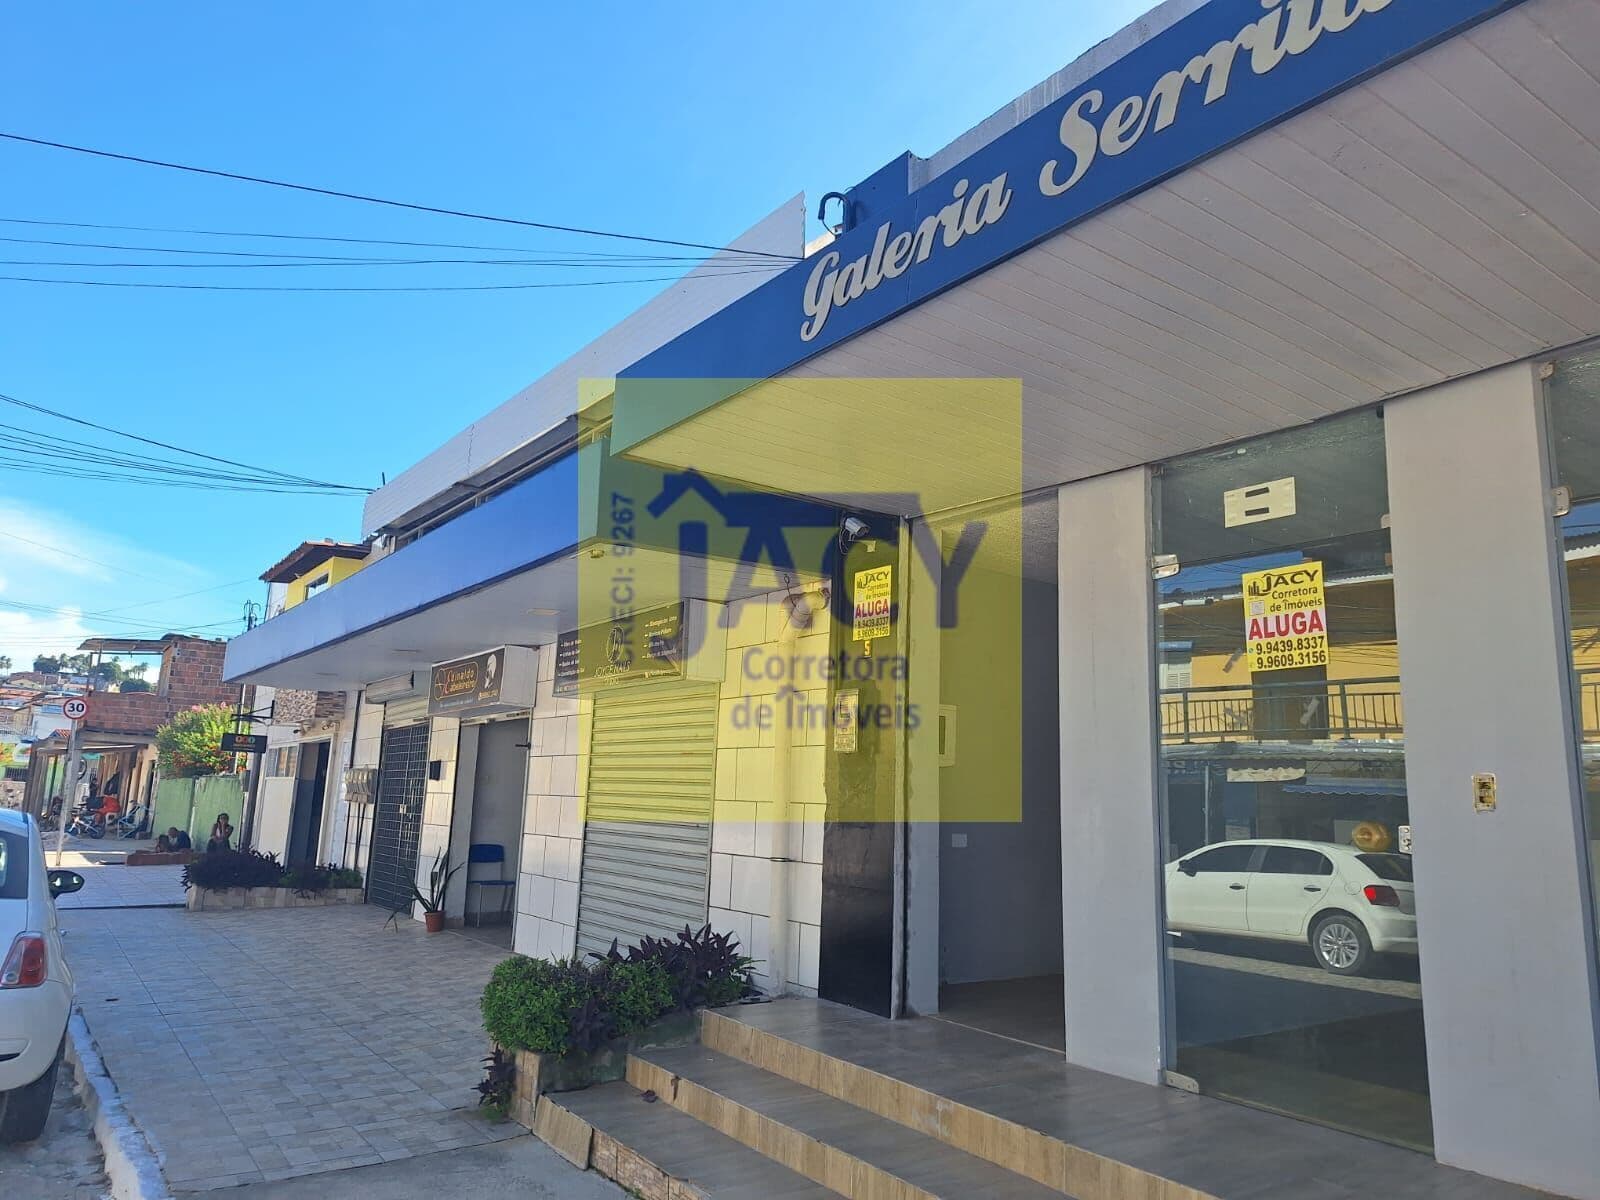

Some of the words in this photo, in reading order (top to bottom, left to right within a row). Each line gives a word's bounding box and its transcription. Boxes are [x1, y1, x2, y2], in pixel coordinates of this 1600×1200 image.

[799, 170, 1014, 342] Galeria
[1261, 569, 1319, 593] JACY
[1271, 586, 1318, 600] Corretora
[855, 598, 889, 619] ALUGA
[1269, 603, 1282, 612] de
[1248, 609, 1324, 641] ALUGA
[1255, 635, 1325, 656] 9.9439.8337
[1256, 650, 1327, 670] 9.9609.3156
[67, 703, 85, 713] 30
